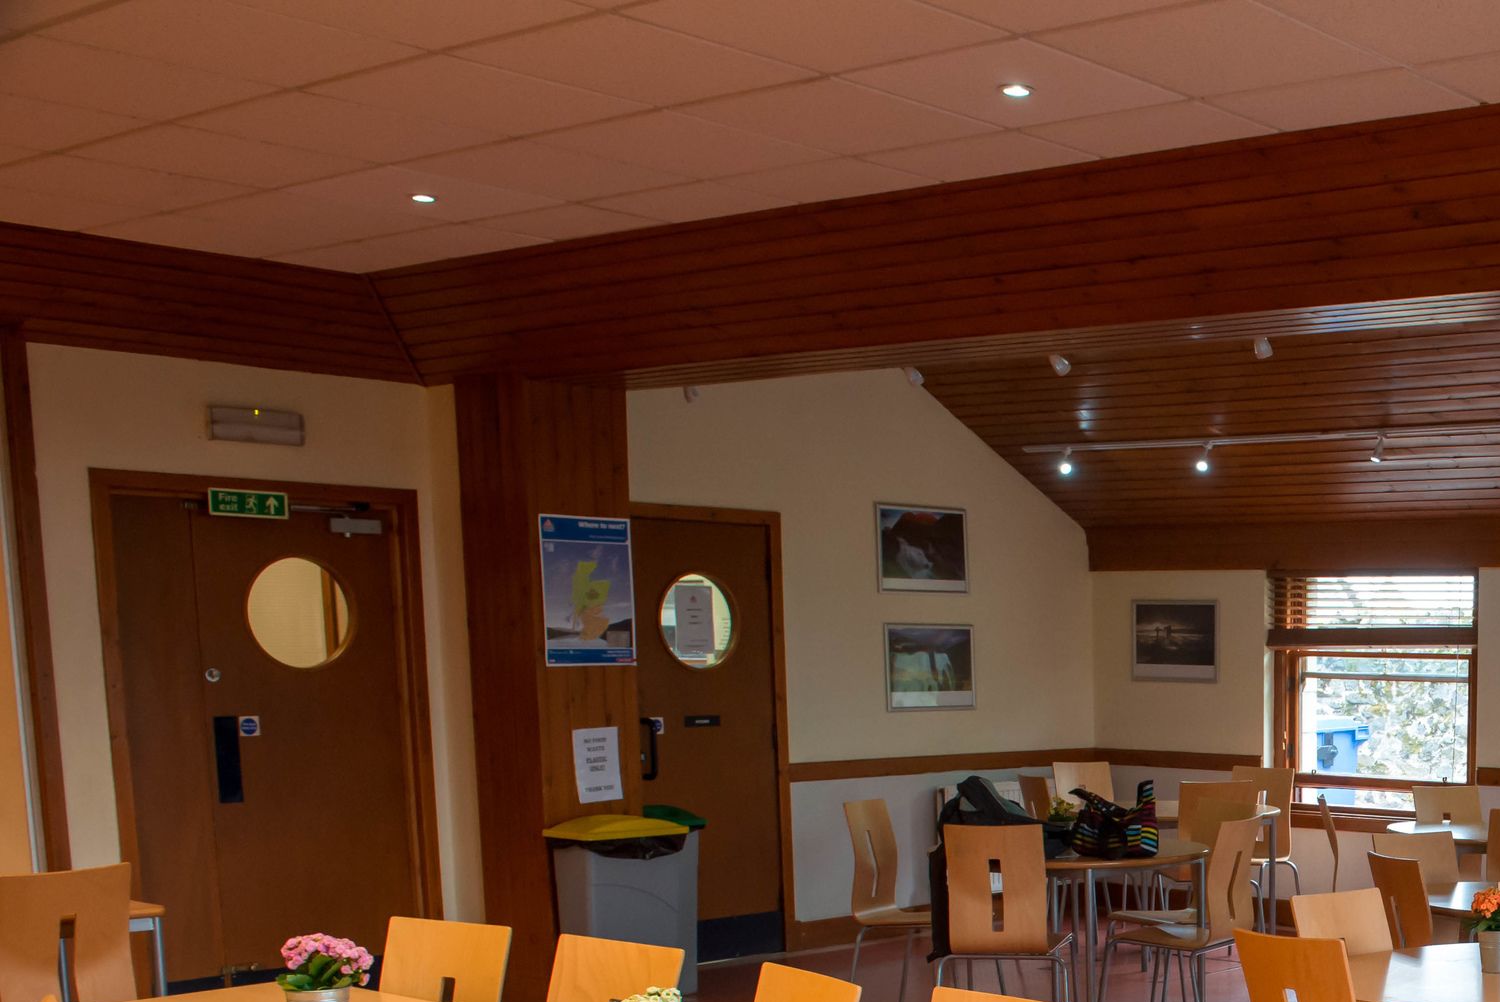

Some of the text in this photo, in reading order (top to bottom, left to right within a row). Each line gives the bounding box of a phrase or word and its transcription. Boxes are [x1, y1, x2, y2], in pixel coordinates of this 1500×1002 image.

[218, 492, 238, 502] Fire
[219, 503, 238, 511] exit
[578, 521, 599, 529] Where
